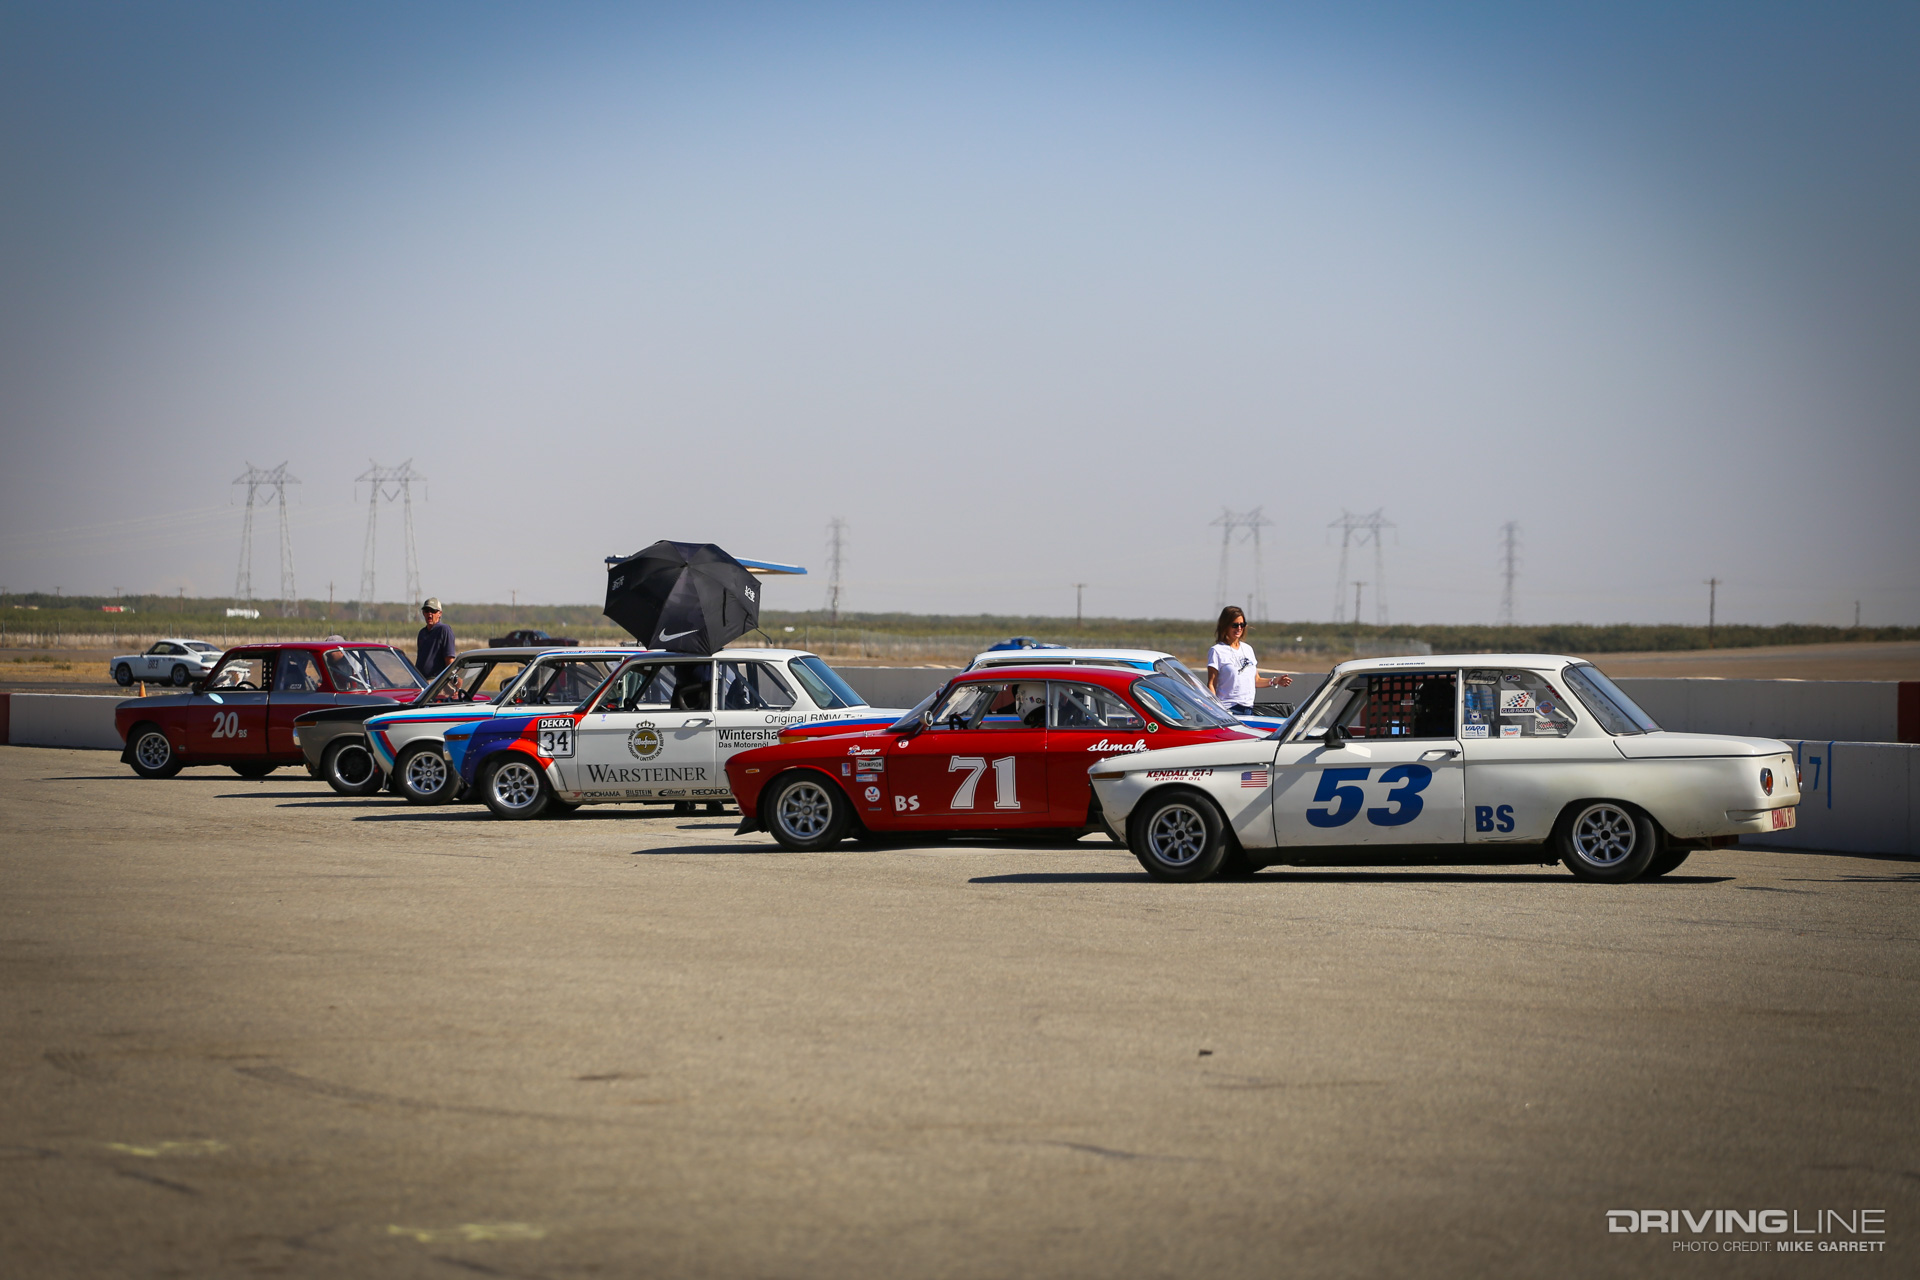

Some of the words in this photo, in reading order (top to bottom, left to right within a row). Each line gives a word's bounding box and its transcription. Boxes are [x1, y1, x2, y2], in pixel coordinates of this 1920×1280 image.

[211, 711, 239, 739] 20
[540, 719, 571, 728] DEKRA
[764, 714, 807, 726] Original
[543, 731, 569, 752] 34
[718, 729, 779, 741] Wintersha
[947, 754, 1021, 810] 71
[1146, 769, 1190, 779] KENDALL
[1192, 769, 1214, 777] GT-1
[691, 788, 729, 796] RECARO
[1305, 764, 1433, 828] 53
[894, 794, 921, 812] BS
[1474, 804, 1515, 833] BS
